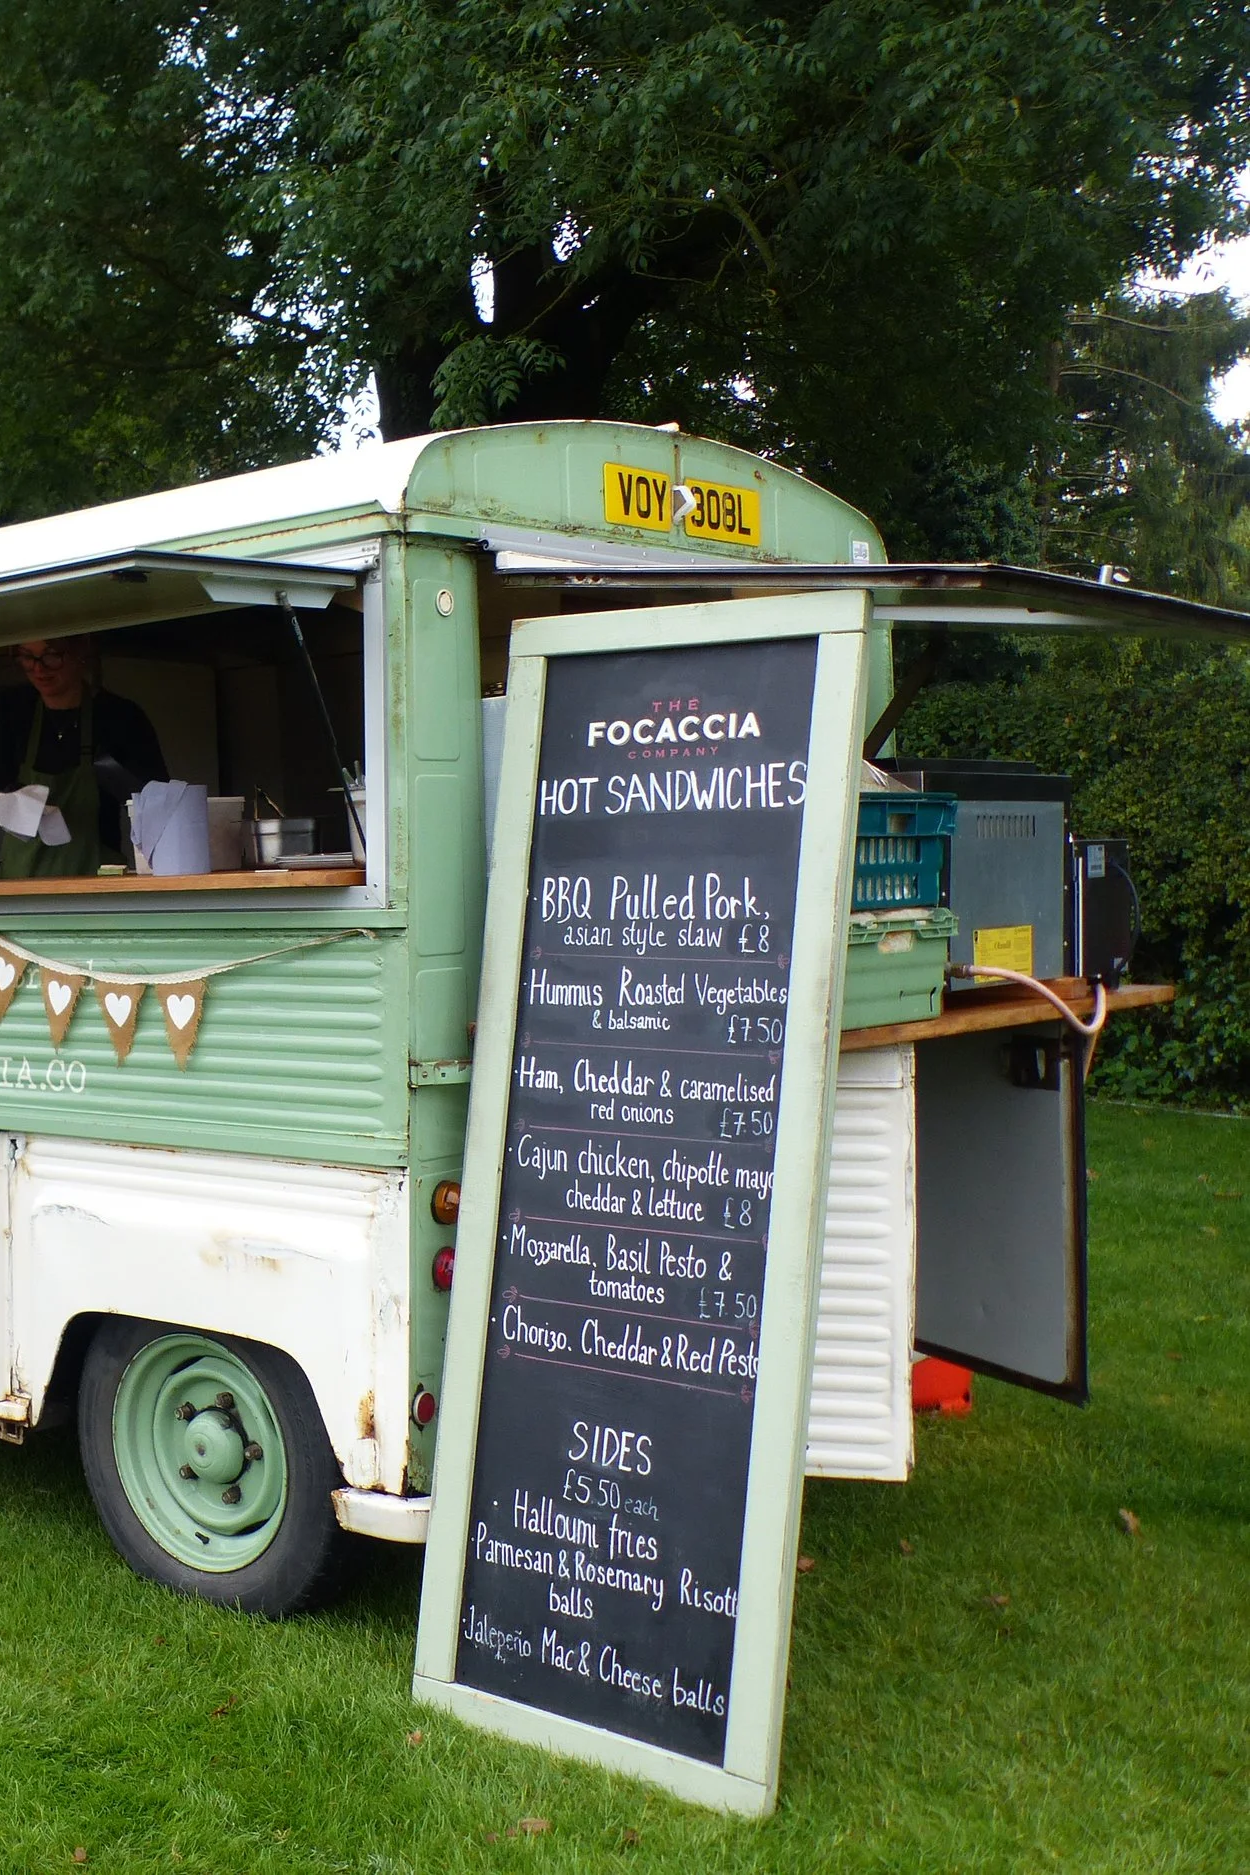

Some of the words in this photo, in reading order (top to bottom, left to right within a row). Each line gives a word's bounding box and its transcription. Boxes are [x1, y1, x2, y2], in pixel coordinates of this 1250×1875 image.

[617, 472, 667, 522] VOY
[690, 486, 751, 536] 308L
[652, 697, 700, 712] THE
[587, 712, 761, 747] FOCACCIA
[628, 746, 719, 759] COMPANY
[540, 776, 599, 816] HOT
[605, 760, 808, 814] SANDWICHES
[541, 877, 591, 923] BBQ
[610, 874, 694, 920] Pulled
[705, 872, 770, 920] Pork,
[564, 925, 611, 947] asian
[622, 921, 665, 955] style
[678, 921, 722, 947] slaw
[739, 923, 770, 954] £8
[529, 967, 603, 1008] Hummus
[619, 966, 685, 1007] Roasted
[694, 972, 788, 1015] Vegetables
[592, 1011, 602, 1029] &
[608, 1010, 670, 1031] balsamic
[519, 1056, 563, 1093] Ham,
[574, 1058, 655, 1097] Cheddar
[659, 1071, 672, 1098] &
[680, 1074, 775, 1102] caramelised
[590, 1099, 614, 1121] red
[622, 1104, 674, 1125] onions
[517, 1134, 568, 1180] Cajun
[578, 1140, 655, 1183] chicken,
[663, 1150, 729, 1190] chipotle
[566, 1181, 626, 1216] cheddar
[632, 1192, 641, 1216] &
[649, 1187, 704, 1222] lettuce
[723, 1196, 751, 1228] £8
[606, 1234, 650, 1275] Basil
[659, 1242, 707, 1280] Pesto
[719, 1252, 732, 1281] &
[589, 1270, 665, 1304] tomatoes
[581, 1318, 657, 1367] Cheddar
[661, 1334, 672, 1366] &
[676, 1336, 711, 1374] Red
[568, 1421, 653, 1475] SIDES
[563, 1469, 620, 1509] £5.50
[625, 1497, 659, 1521] each
[514, 1489, 599, 1549] Halloumi
[609, 1514, 658, 1560] fries
[476, 1522, 552, 1576] Parmesan
[558, 1549, 570, 1579] &
[575, 1551, 664, 1611] Rosemary
[680, 1568, 740, 1618] Risott
[549, 1583, 594, 1619] balls
[541, 1626, 573, 1672] Mac
[578, 1641, 590, 1676] &
[599, 1646, 663, 1698] Cheese
[673, 1668, 725, 1717] balls
